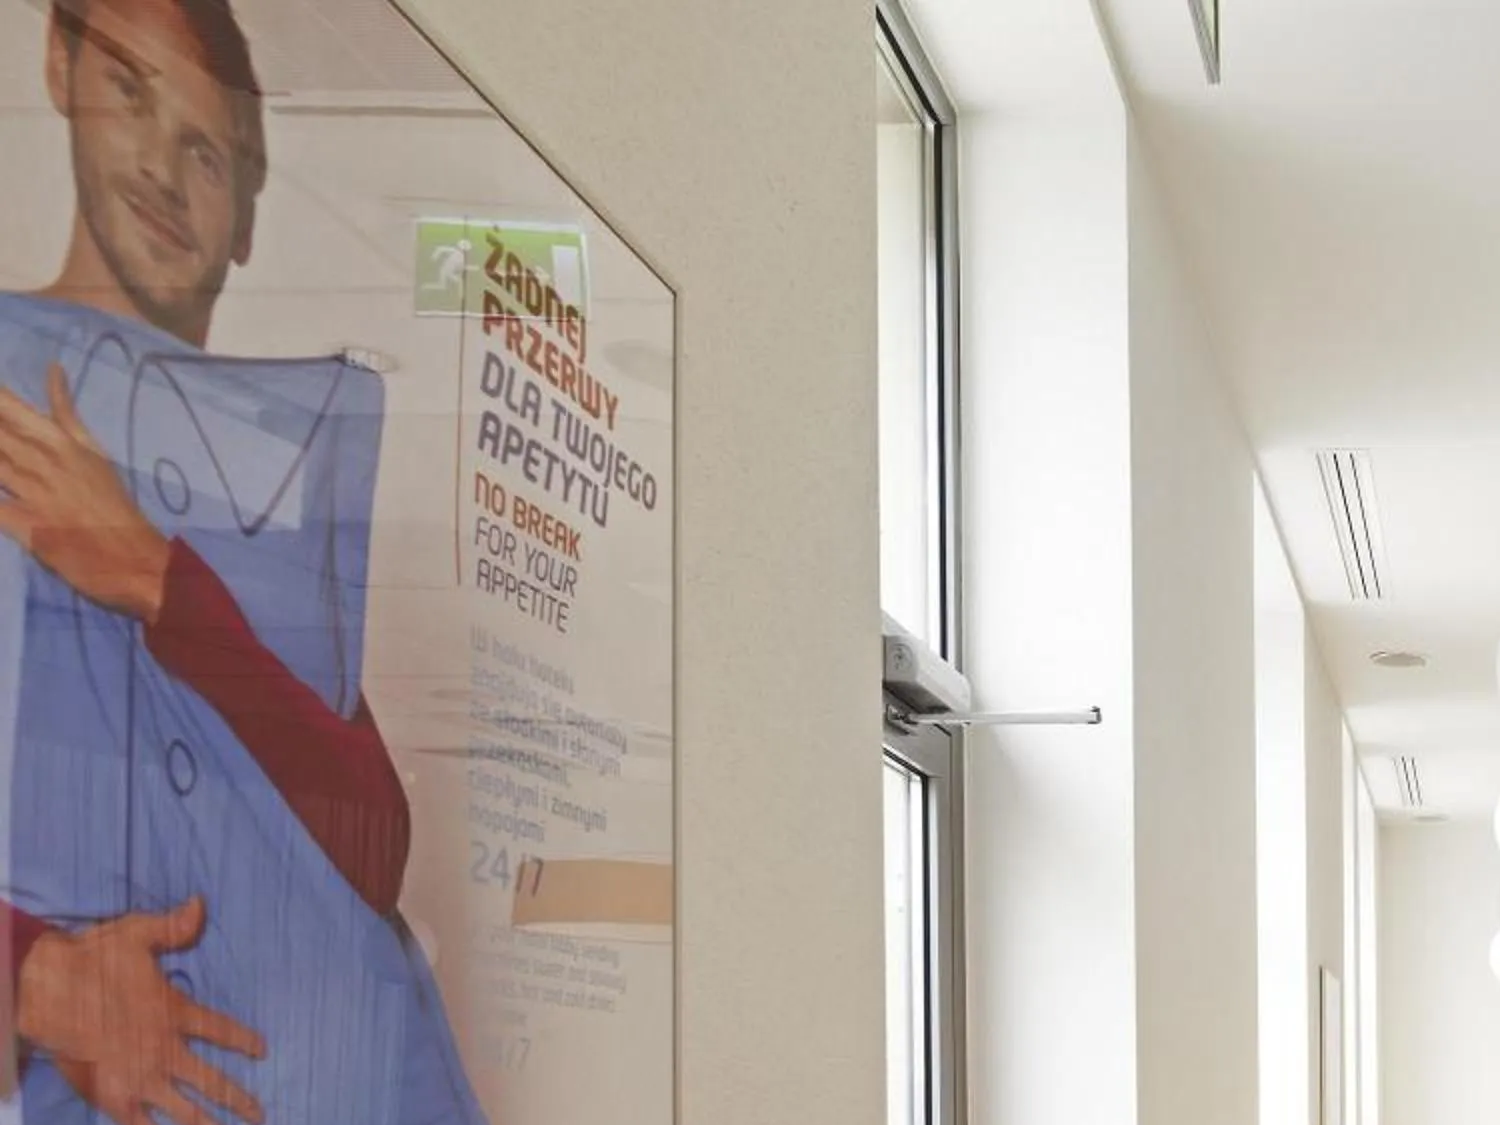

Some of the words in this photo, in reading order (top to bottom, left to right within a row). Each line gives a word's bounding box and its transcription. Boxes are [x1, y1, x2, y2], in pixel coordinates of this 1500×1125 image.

[485, 224, 586, 364] ŻADNEJ
[483, 290, 618, 431] PRZERWY
[478, 411, 609, 527] APETYTU
[480, 351, 541, 427] DLA
[552, 398, 657, 511] TWOJEGO
[475, 472, 505, 517] NO
[513, 496, 581, 561] BREAK
[475, 516, 516, 566] FOR
[524, 541, 577, 597] YOUR
[476, 558, 570, 633] APPETITE
[471, 840, 544, 898] 24/7
